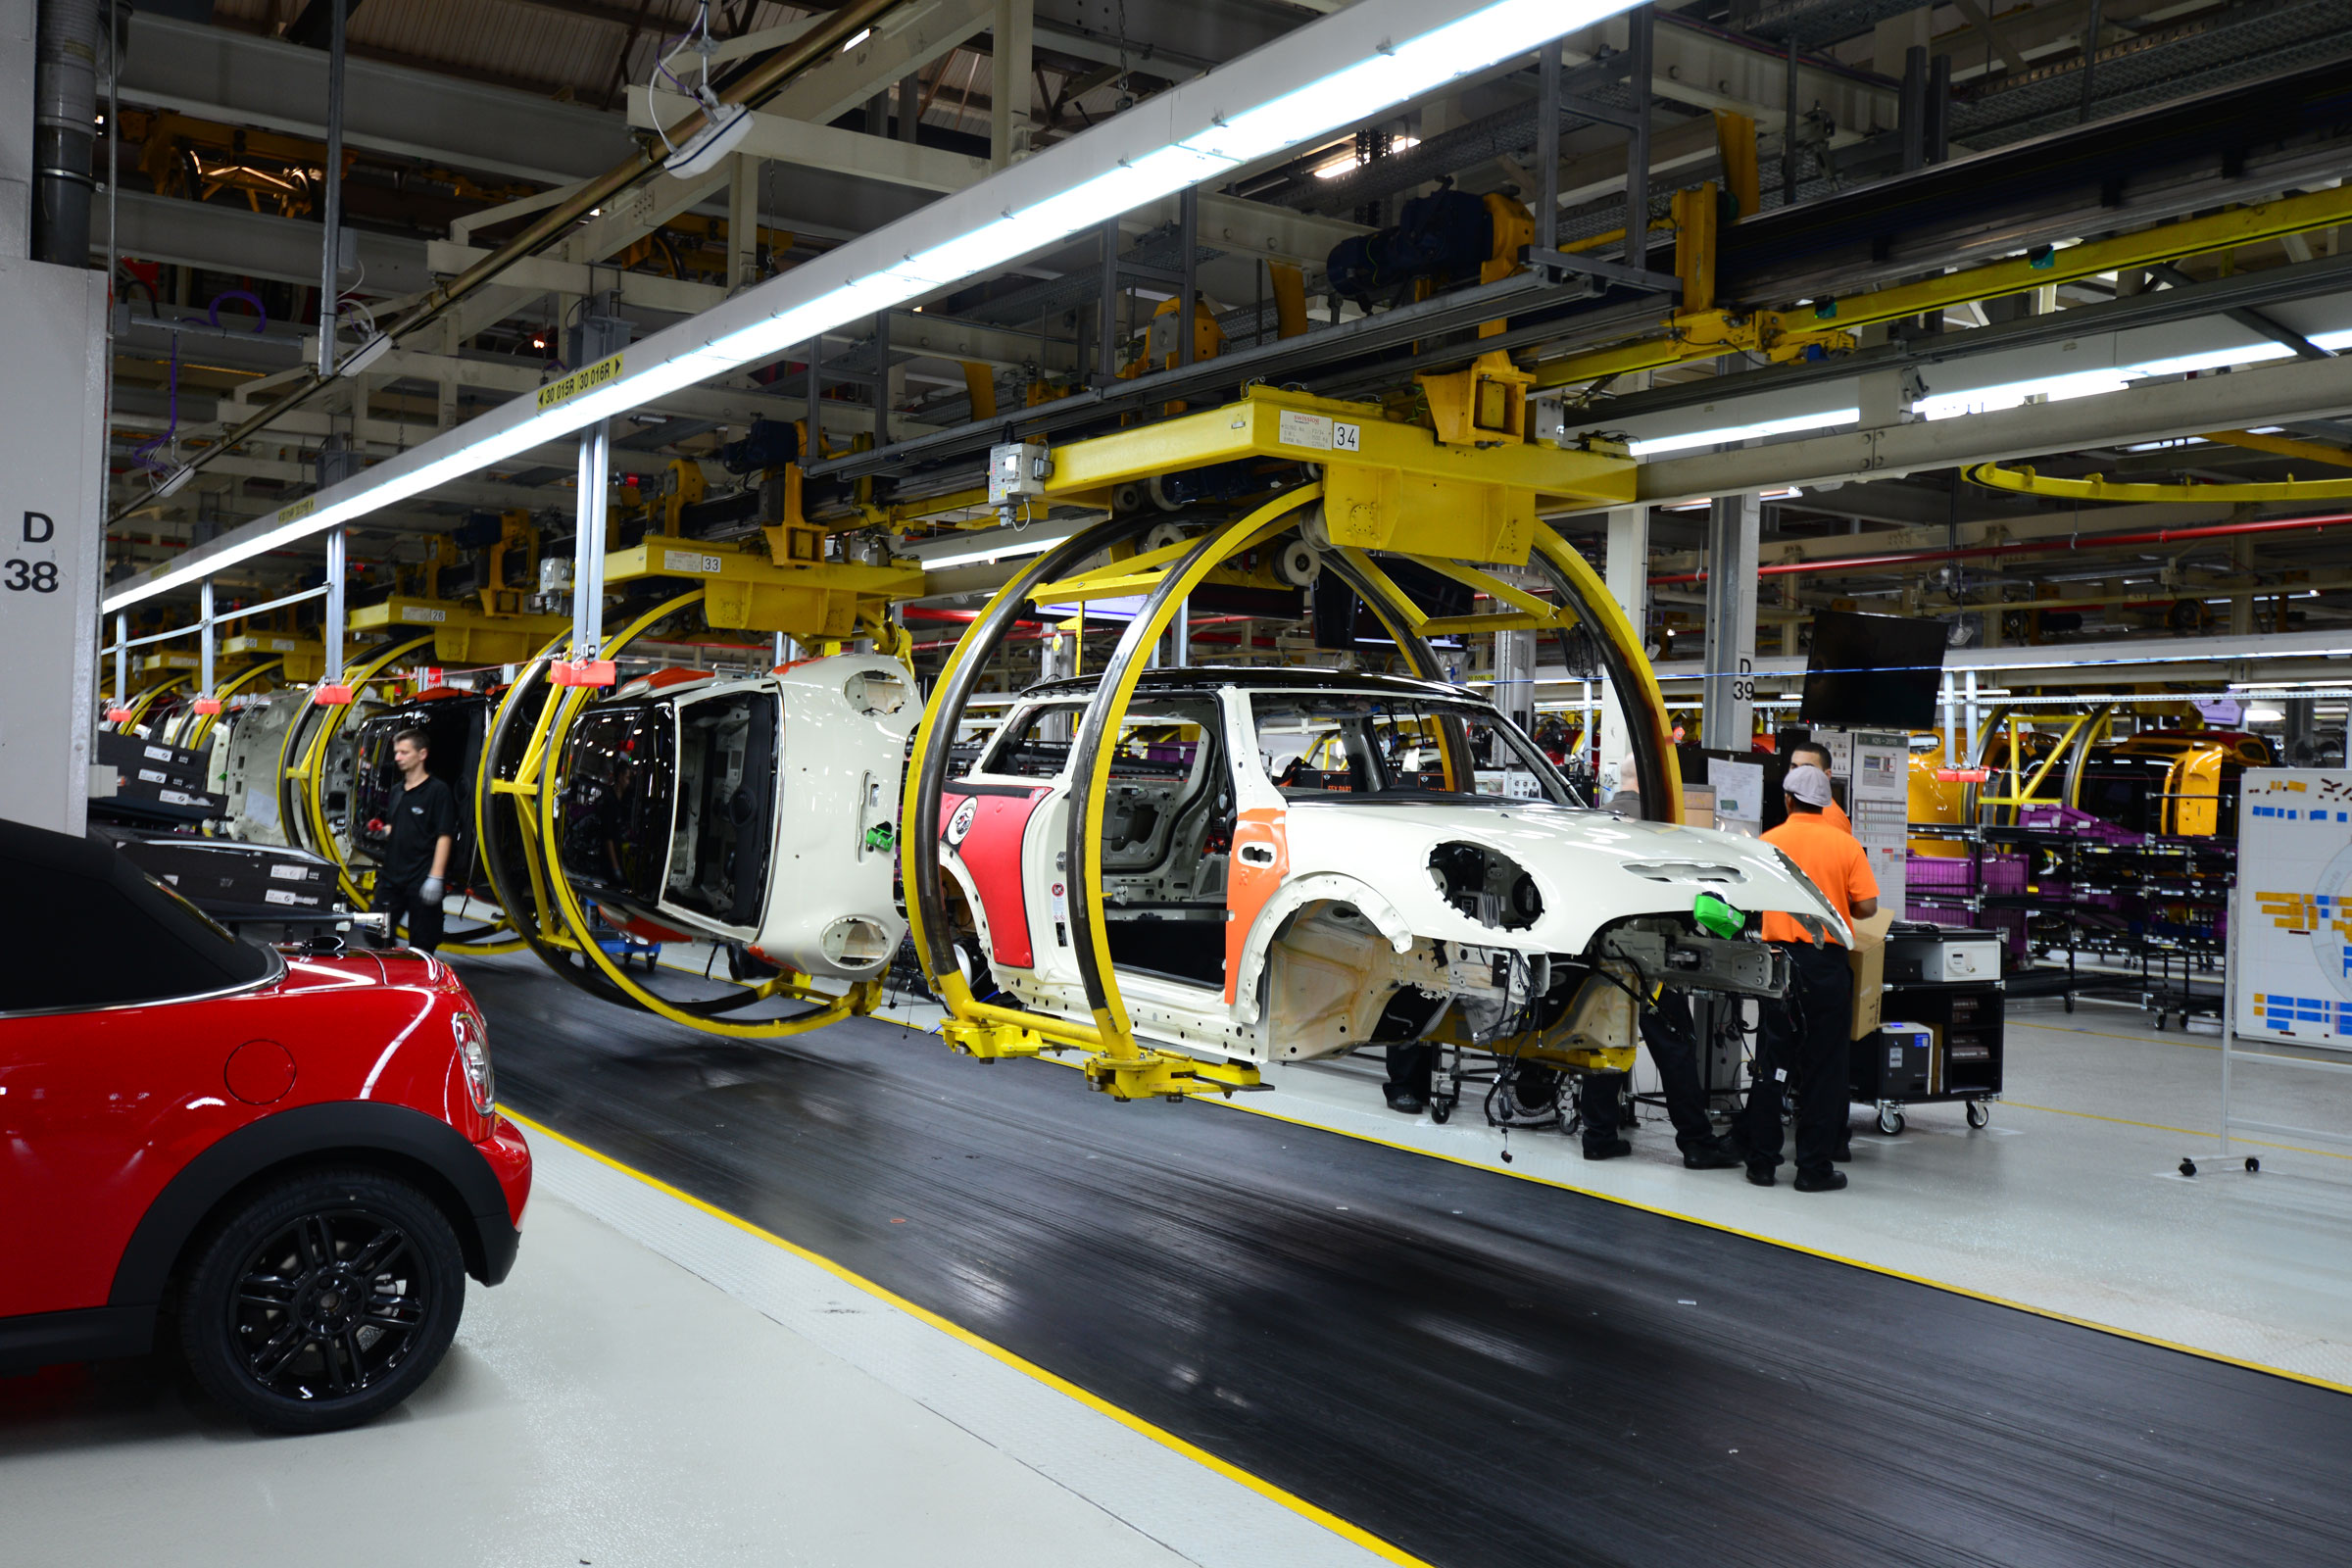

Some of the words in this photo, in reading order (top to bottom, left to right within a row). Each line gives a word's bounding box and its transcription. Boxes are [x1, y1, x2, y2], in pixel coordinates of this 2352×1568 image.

[557, 378, 574, 400] 015R
[580, 372, 588, 390] 30
[591, 362, 611, 384] 016R
[1337, 426, 1355, 447] 34
[24, 511, 54, 543] D
[706, 558, 718, 571] 33
[4, 559, 59, 593] 38
[432, 611, 444, 621] 26
[1740, 658, 1752, 677] D
[1733, 681, 1754, 702] 39
